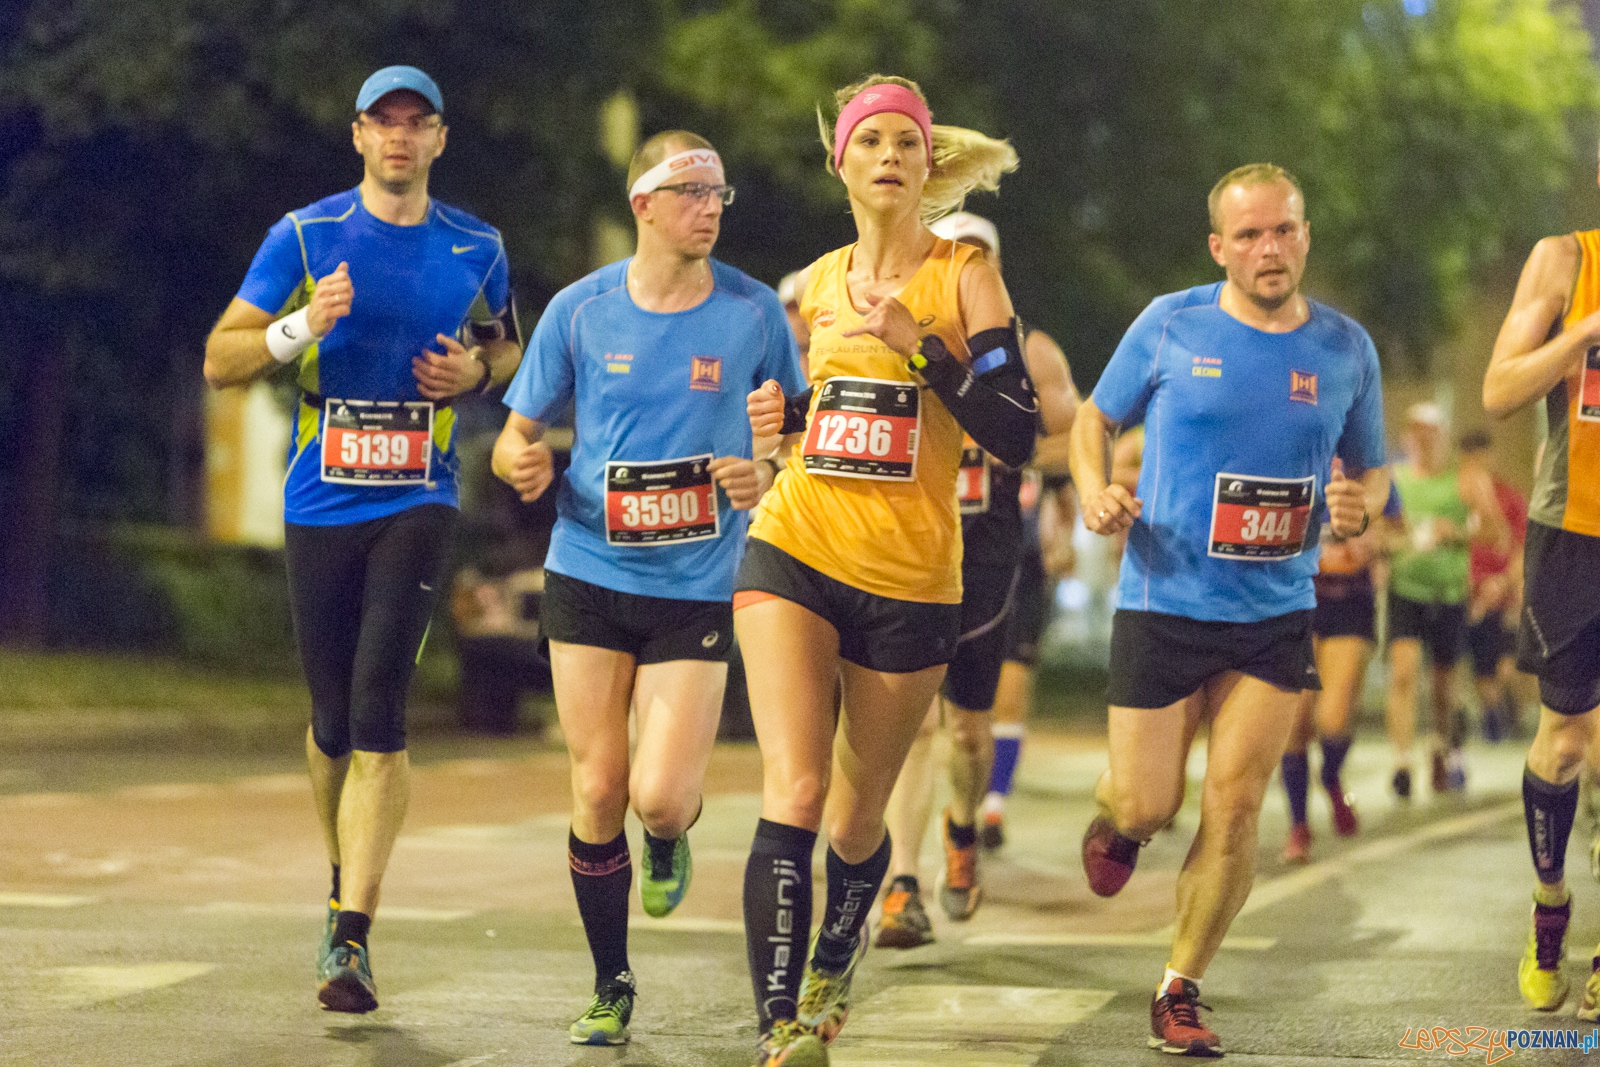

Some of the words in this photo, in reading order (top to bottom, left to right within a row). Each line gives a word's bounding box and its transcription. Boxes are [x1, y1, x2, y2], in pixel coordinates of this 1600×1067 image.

[852, 344, 879, 353] RUN
[340, 432, 409, 466] 5139
[816, 414, 893, 457] 1236
[621, 490, 699, 527] 3590
[1240, 509, 1292, 541] 344
